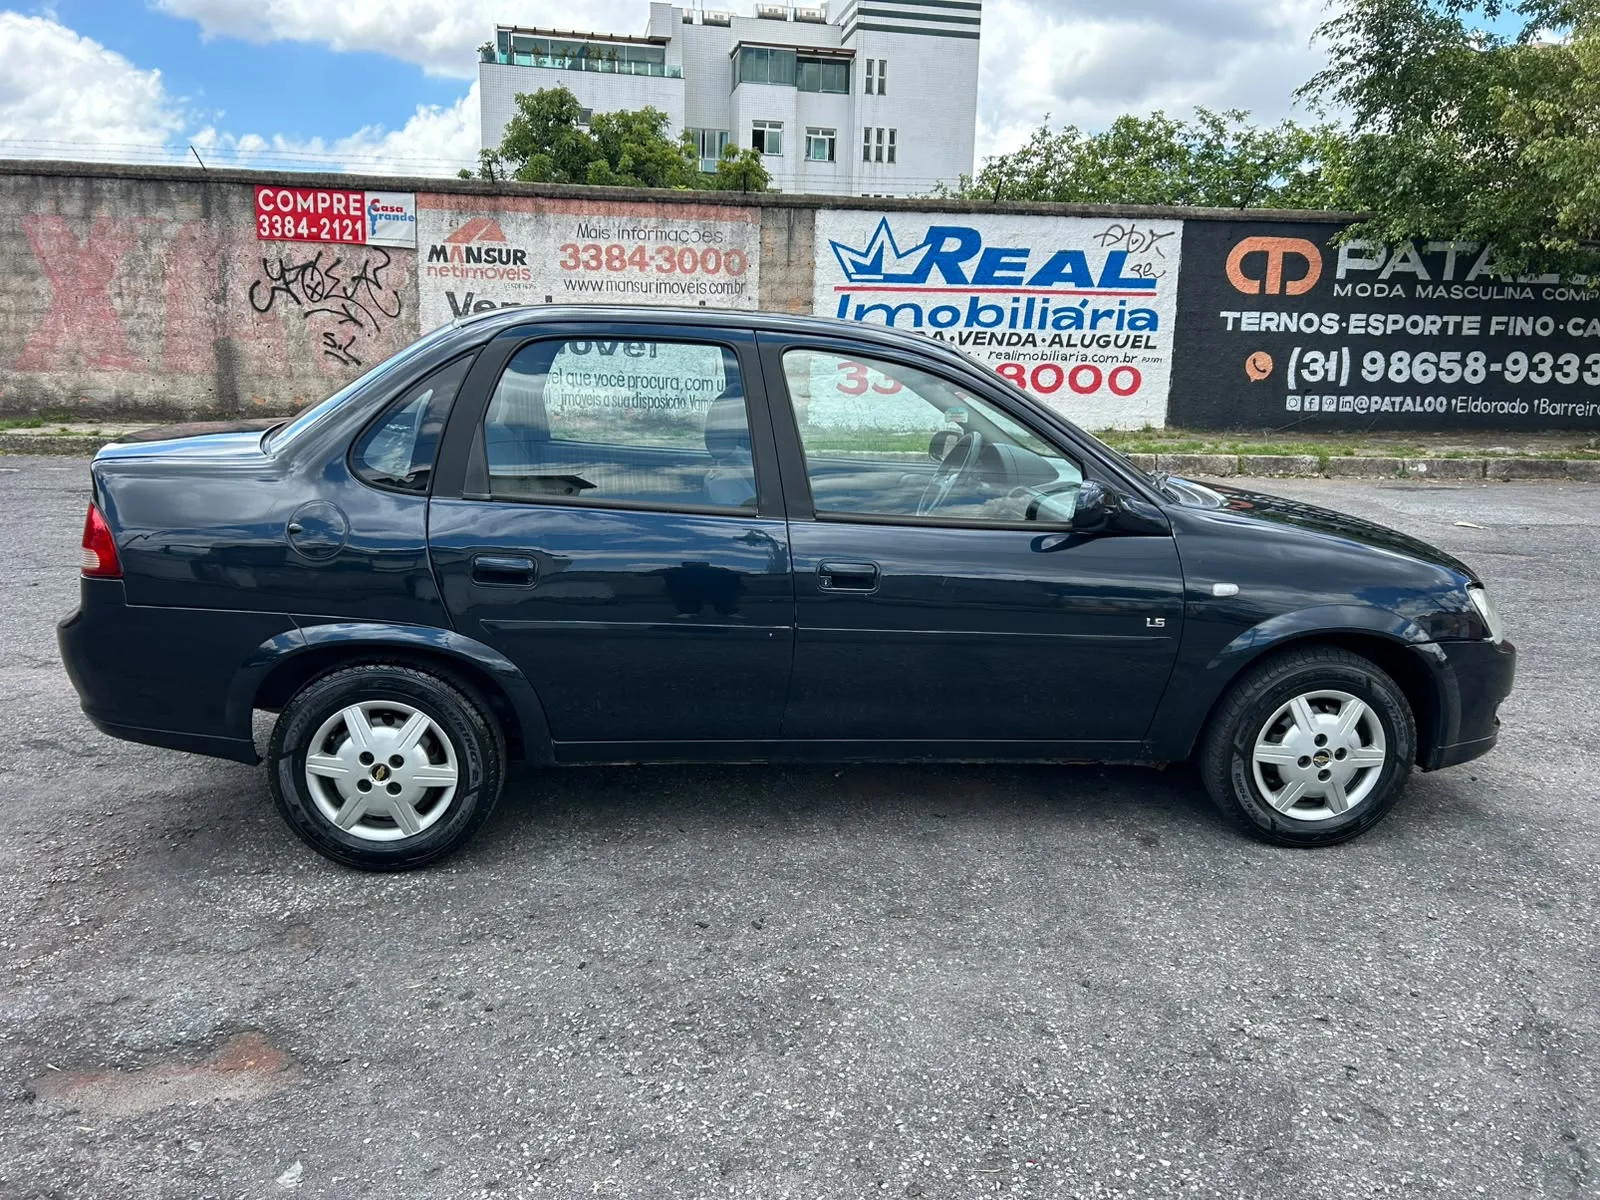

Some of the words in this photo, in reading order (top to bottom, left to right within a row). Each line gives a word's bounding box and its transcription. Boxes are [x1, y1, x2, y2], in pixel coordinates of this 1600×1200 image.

[258, 188, 362, 216] COMPRE
[370, 198, 404, 213] Casa
[259, 214, 362, 241] 3384-2121
[576, 223, 611, 239] Mais
[427, 244, 527, 266] MANSUR
[915, 225, 1157, 289] REAL
[563, 278, 746, 296] www.mansurimoveis.com.br
[1333, 283, 1406, 298] MODA
[1415, 283, 1535, 300] MASCULINA
[837, 293, 1159, 332] Imobiliária
[1220, 311, 1340, 334] TERNOS
[1347, 313, 1482, 336] ESPORTE
[1489, 315, 1555, 337] FINO
[956, 331, 1038, 348] VENDA
[1049, 333, 1157, 350] ALUGUEL
[988, 350, 1138, 364] realimobiliaria.com.br
[1287, 346, 1350, 390] (31)
[1361, 350, 1600, 386] 98658-9333
[566, 371, 592, 388] que
[593, 370, 626, 387] você
[684, 377, 714, 392] com
[1456, 396, 1529, 414] Eldorado
[1146, 617, 1165, 628] LS
